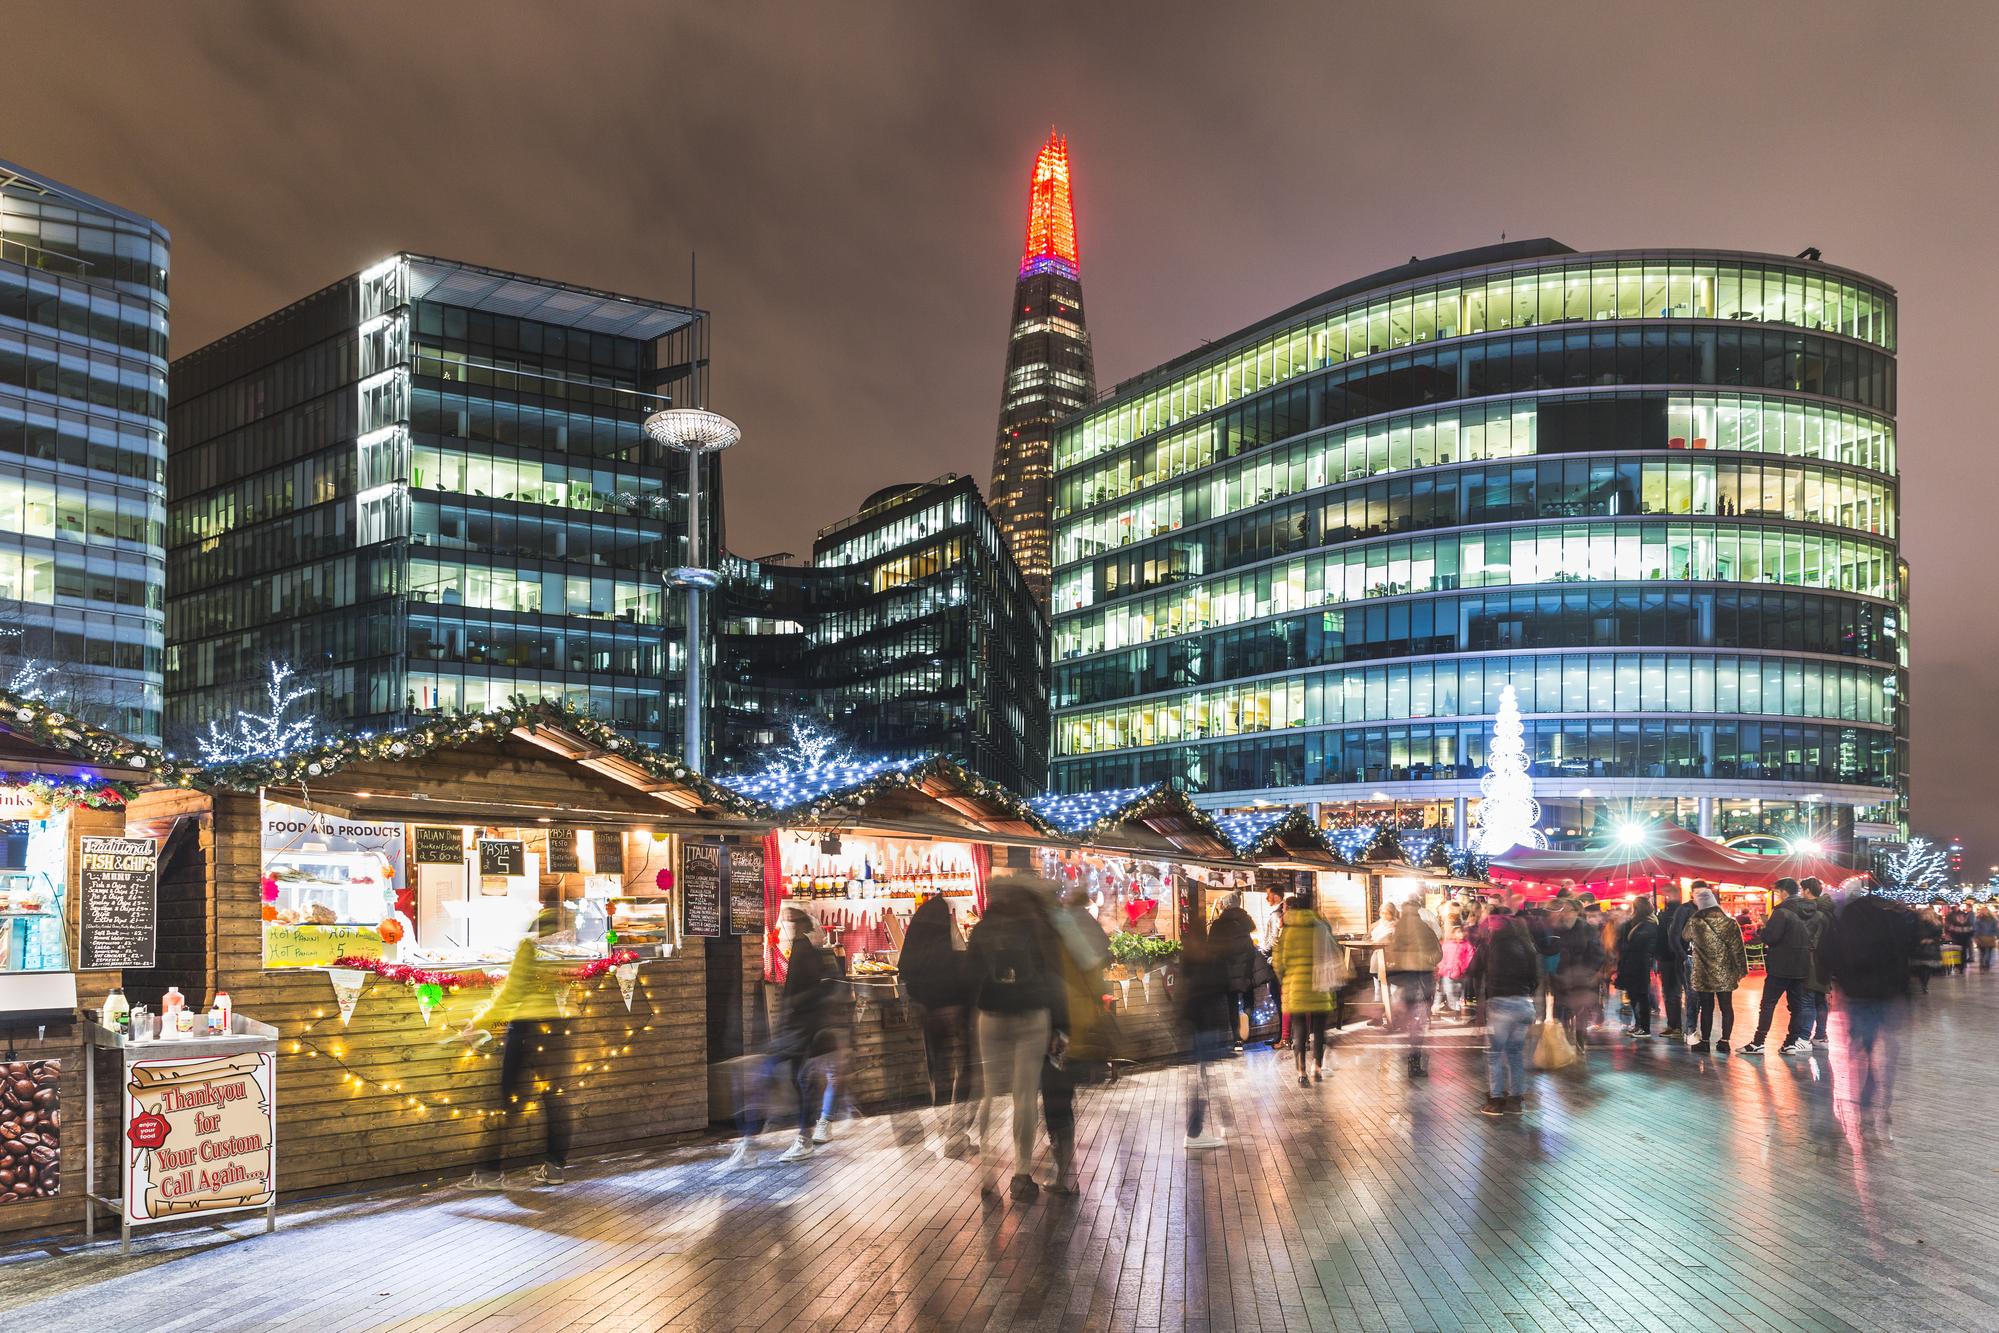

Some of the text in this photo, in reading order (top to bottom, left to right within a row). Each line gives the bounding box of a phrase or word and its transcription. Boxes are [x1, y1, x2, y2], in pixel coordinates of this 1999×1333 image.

[268, 821, 401, 838] FOOD AND PRODUCTS
[416, 828, 445, 841] ITALIAN
[82, 838, 153, 856] Traditional
[480, 842, 510, 858] PASTA
[685, 845, 719, 868] ITALIAN
[92, 880, 105, 888] Fish
[111, 881, 126, 890] Chips
[101, 872, 132, 881] MENU
[108, 893, 124, 901] Chips
[162, 1081, 247, 1114] Thankyou
[138, 1121, 158, 1129] enjoy
[194, 1111, 220, 1136] for
[155, 1134, 263, 1172] Your Custom
[161, 1169, 196, 1199] Call
